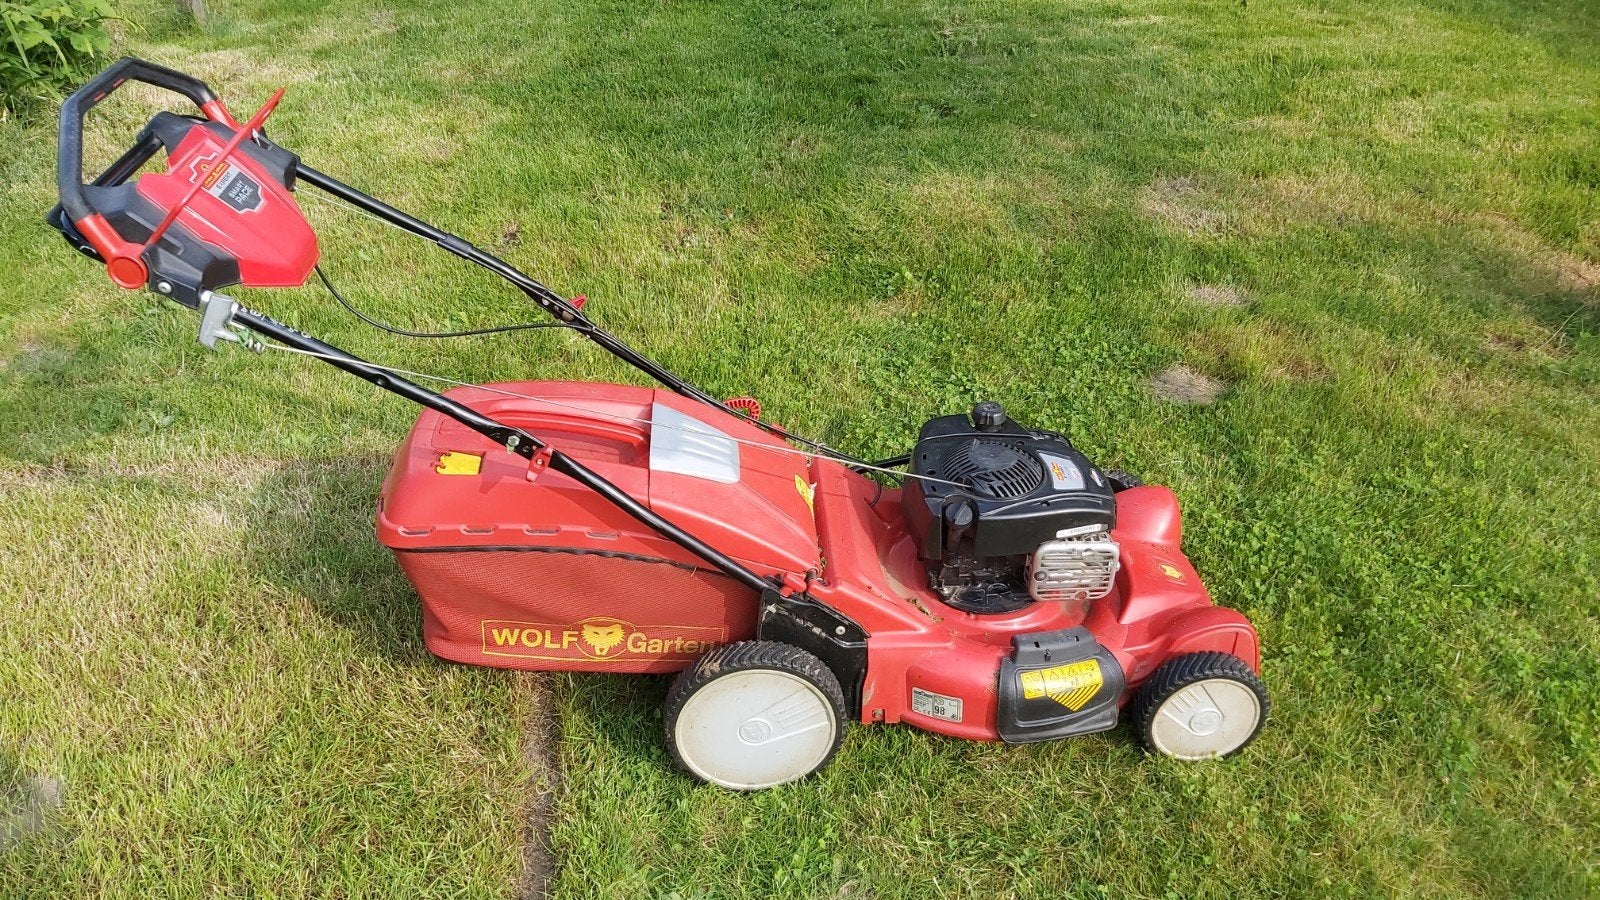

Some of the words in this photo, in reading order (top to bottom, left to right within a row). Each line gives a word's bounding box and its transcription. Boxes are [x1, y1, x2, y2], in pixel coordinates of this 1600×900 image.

[228, 179, 246, 198] SMART
[234, 184, 254, 205] PACE
[491, 628, 579, 650] WOLF
[627, 632, 715, 654] Garten
[934, 705, 945, 715] 98
